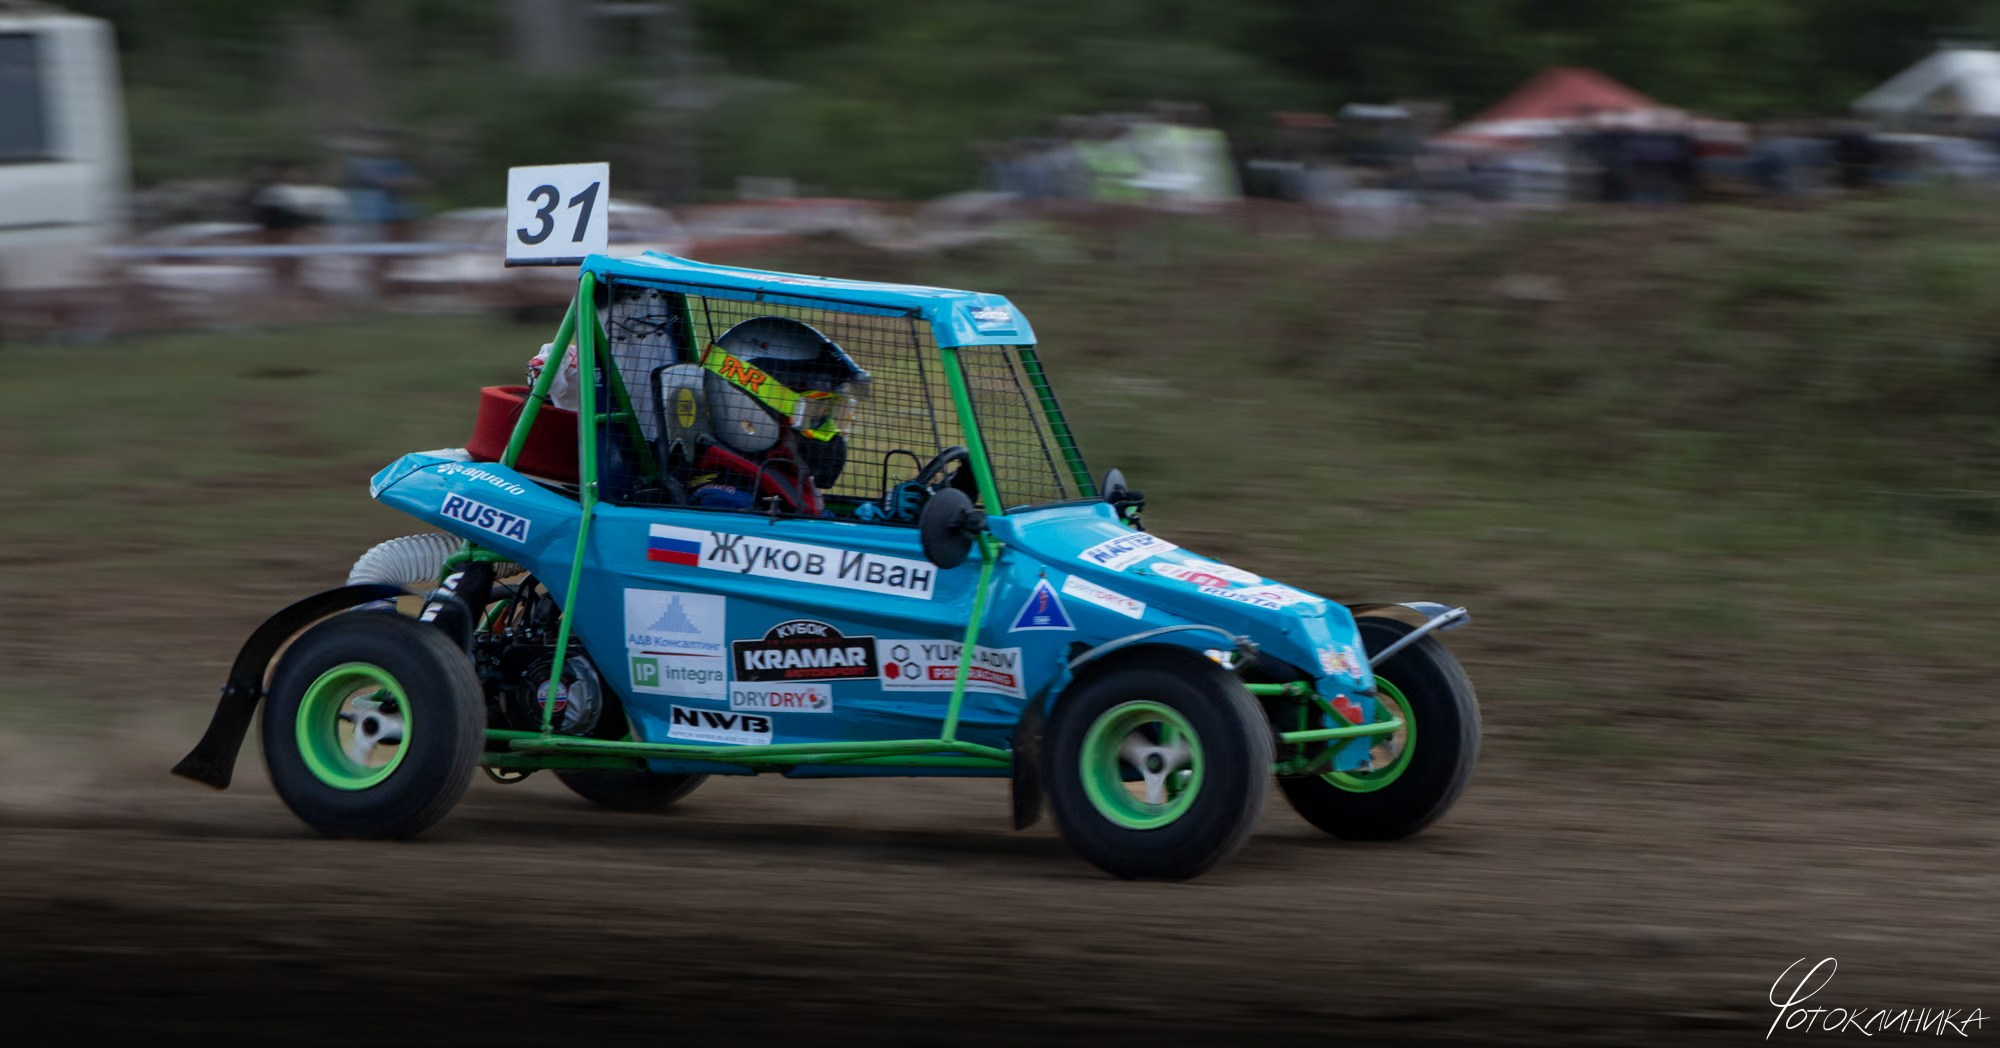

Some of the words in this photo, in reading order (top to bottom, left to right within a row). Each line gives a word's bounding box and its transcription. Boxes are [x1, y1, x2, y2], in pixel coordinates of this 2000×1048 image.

[517, 181, 600, 245] 31
[461, 467, 525, 495] aquario
[443, 495, 527, 541] RUSTA
[707, 531, 826, 574] Жуков
[837, 550, 932, 591] Иван
[628, 633, 653, 646] АДВ
[776, 622, 828, 638] КУБОК
[743, 647, 867, 670] KRAMAR
[635, 663, 657, 681] IP
[665, 665, 724, 684] integra
[672, 707, 771, 733] NWB
